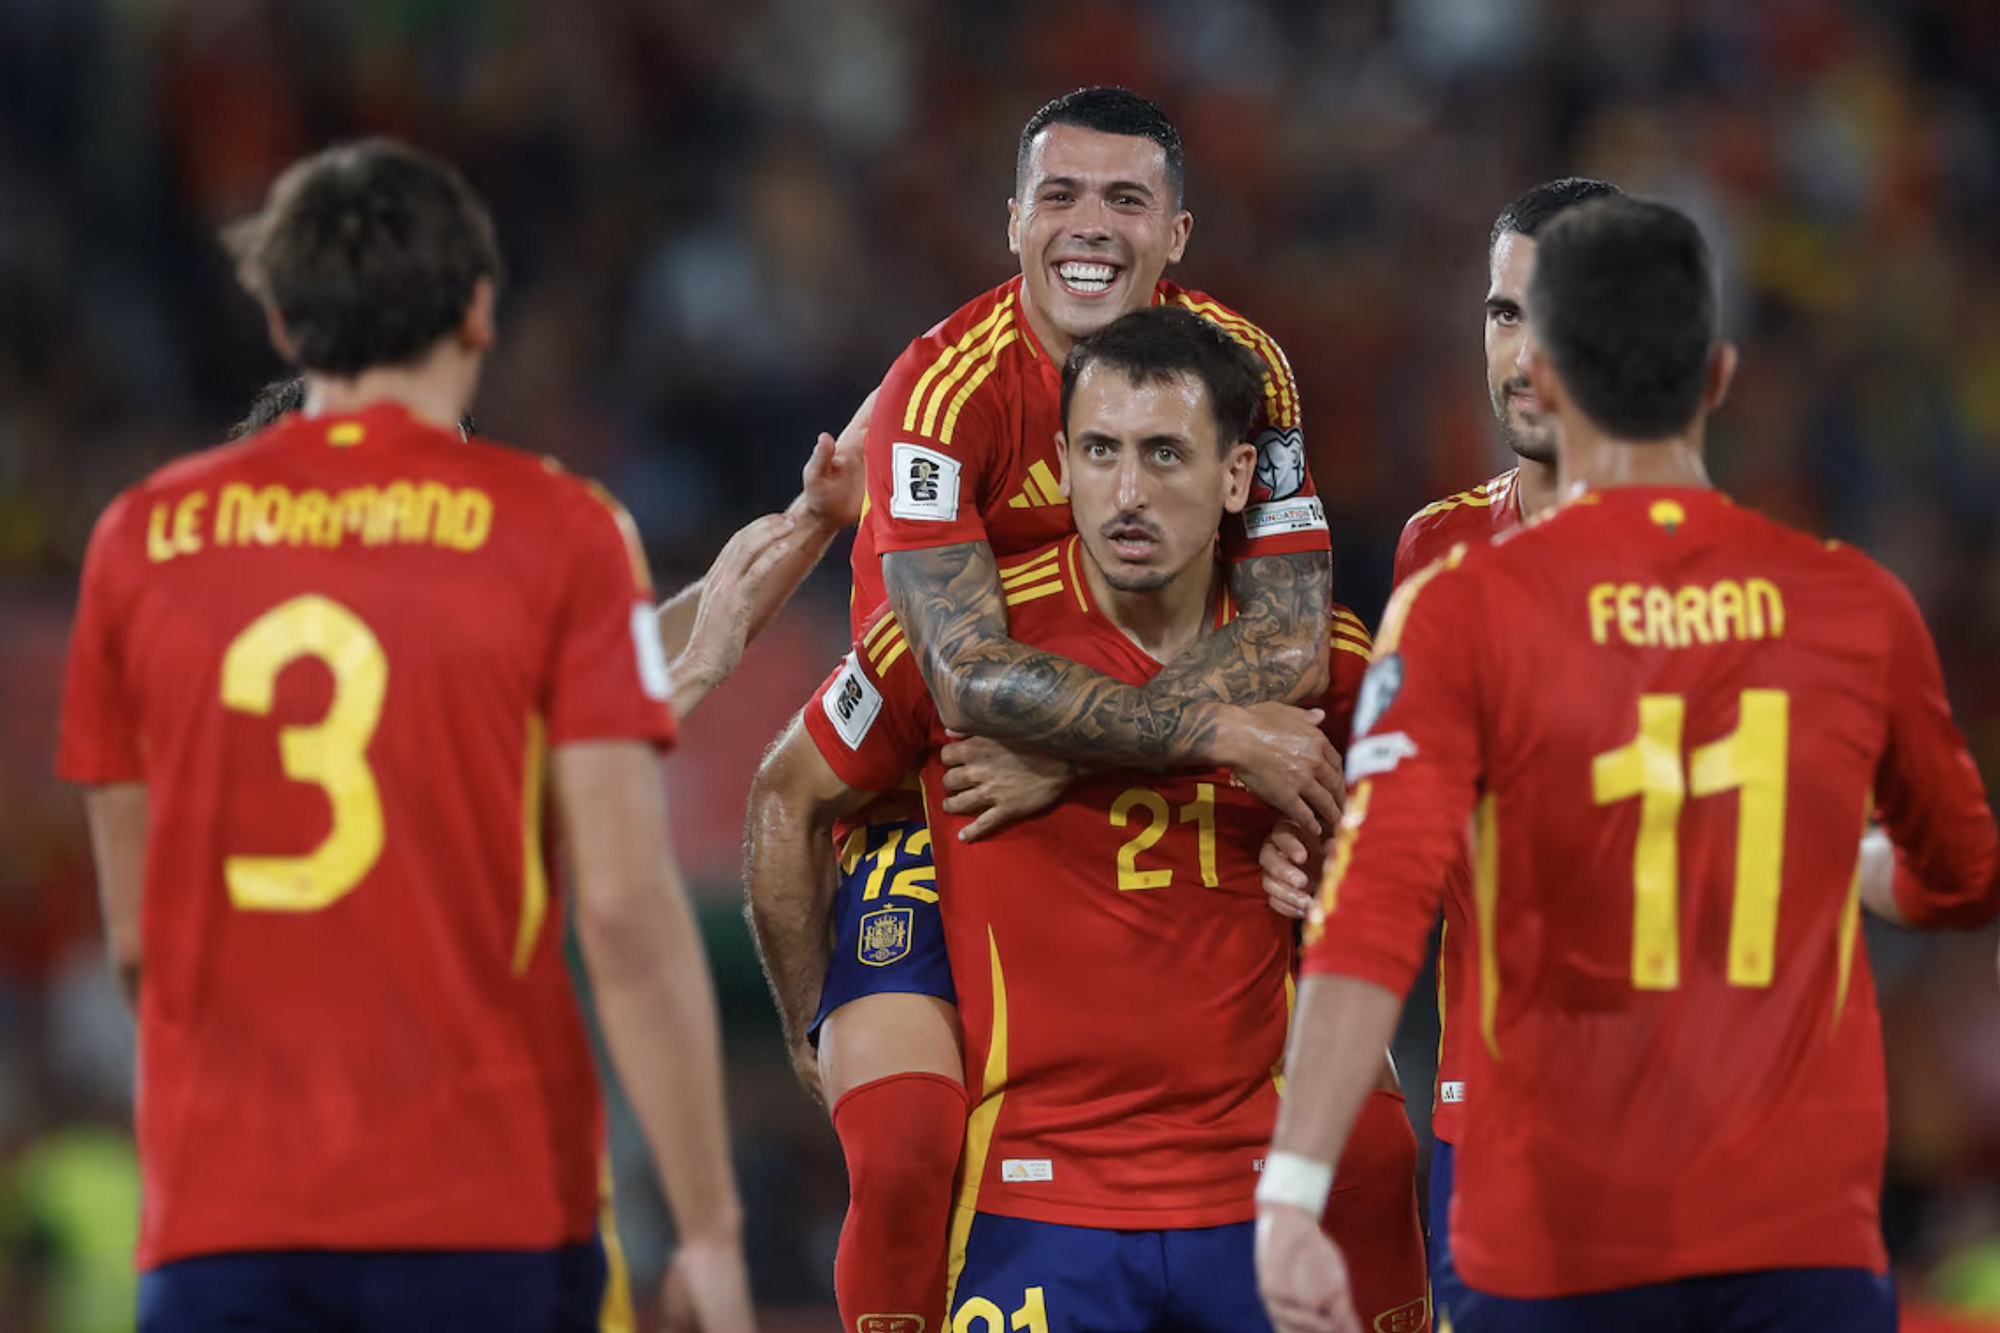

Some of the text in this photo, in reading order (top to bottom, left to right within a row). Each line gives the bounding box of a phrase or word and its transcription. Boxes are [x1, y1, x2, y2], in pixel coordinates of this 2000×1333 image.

[148, 480, 494, 563] LE NORMAND
[1588, 577, 1785, 649] FERRAN
[221, 594, 389, 912] 3
[1109, 783, 1219, 891] 21
[1591, 688, 1789, 990] 11
